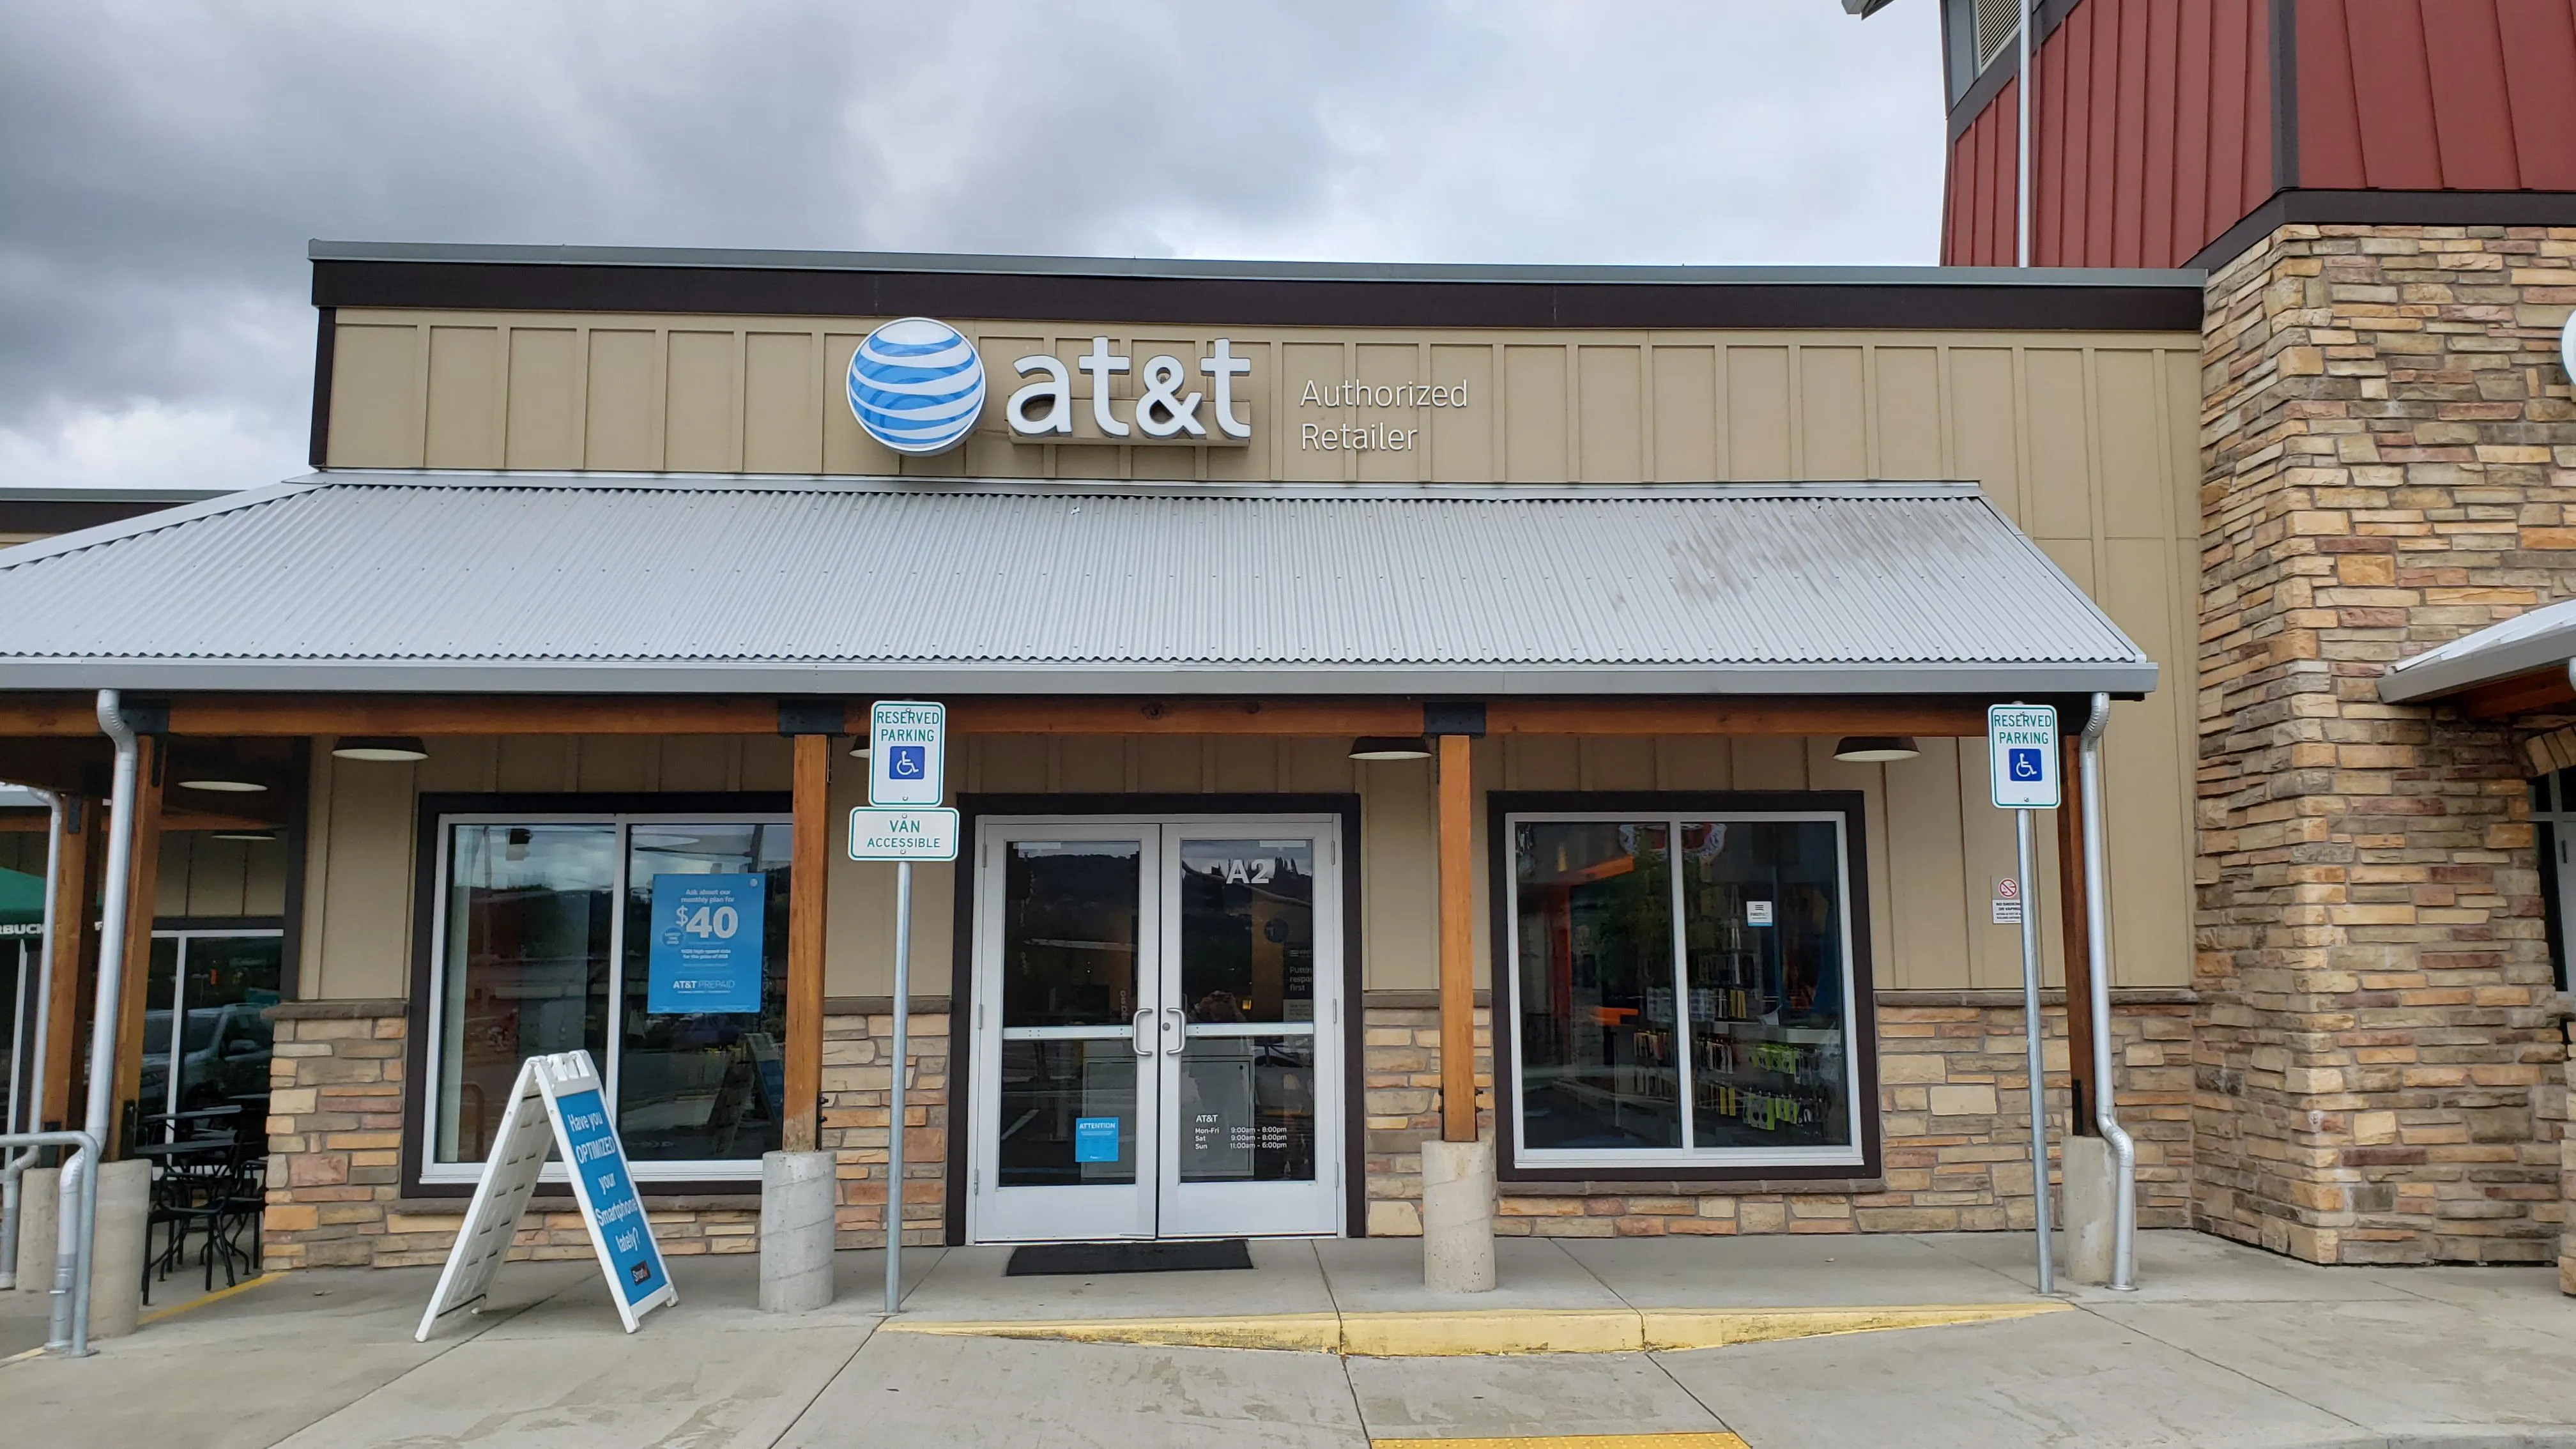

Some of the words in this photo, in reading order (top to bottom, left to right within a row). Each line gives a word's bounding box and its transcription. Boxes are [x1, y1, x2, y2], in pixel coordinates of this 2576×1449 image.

[1006, 335, 1251, 439] at&t
[1300, 379, 1468, 408] Authorized
[1301, 422, 1418, 450] Retailer
[877, 711, 939, 724] RESERVED
[1994, 714, 2051, 727] RESERVED
[880, 729, 934, 742] PARKING
[1998, 732, 2049, 744] PARKING
[889, 820, 921, 833] VAN
[867, 838, 940, 848] ACCESSIBLE
[1226, 859, 1269, 884] A2
[0, 923, 45, 935] BUCK
[676, 905, 739, 939] $40
[673, 980, 698, 989] AT&T
[698, 980, 735, 989] PREPAID
[567, 1114, 590, 1132] Have
[588, 1112, 604, 1132] you
[1195, 1114, 1218, 1123] AT&T
[576, 1136, 615, 1164] OPTIMIZED
[598, 1173, 616, 1195] your
[595, 1198, 638, 1227] Smartphone
[615, 1226, 640, 1253] lately?
